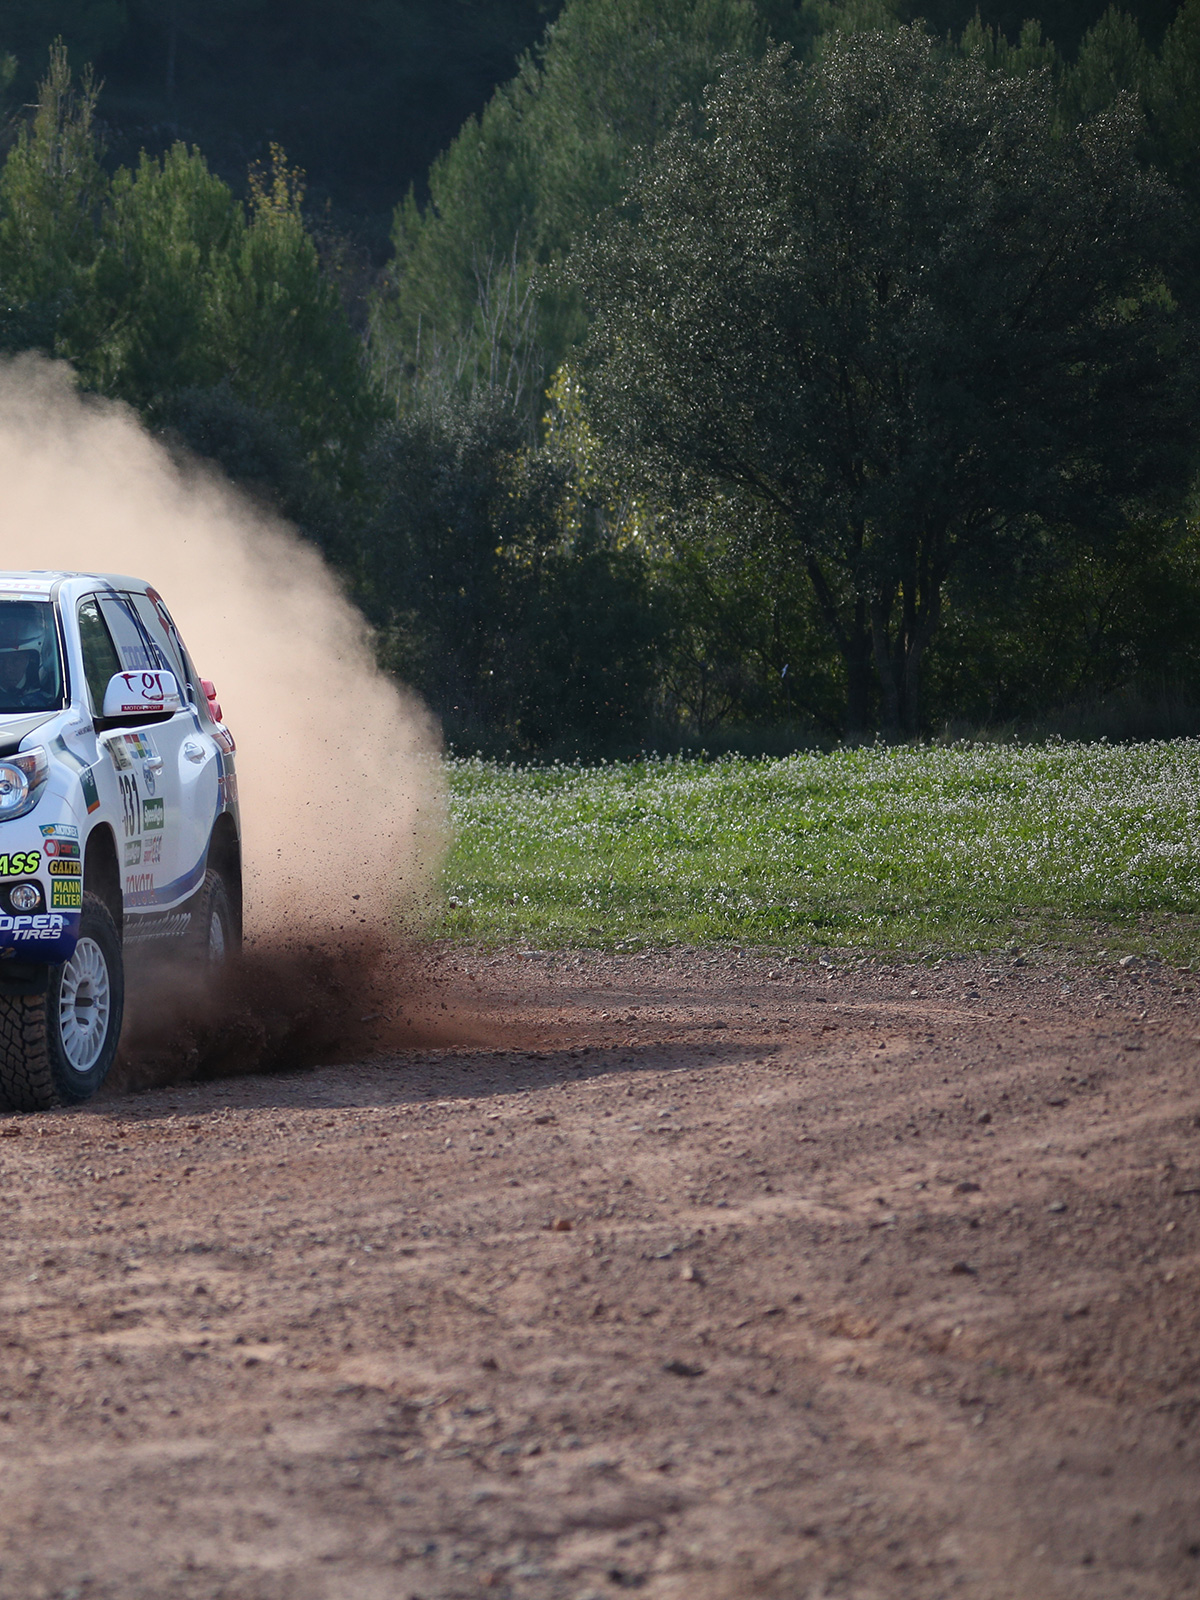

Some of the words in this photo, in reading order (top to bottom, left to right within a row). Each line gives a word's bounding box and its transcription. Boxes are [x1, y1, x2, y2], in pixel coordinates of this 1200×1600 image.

[53, 881, 81, 893] MANN
[53, 894, 81, 906] FILTER
[11, 928, 62, 941] TIRES
